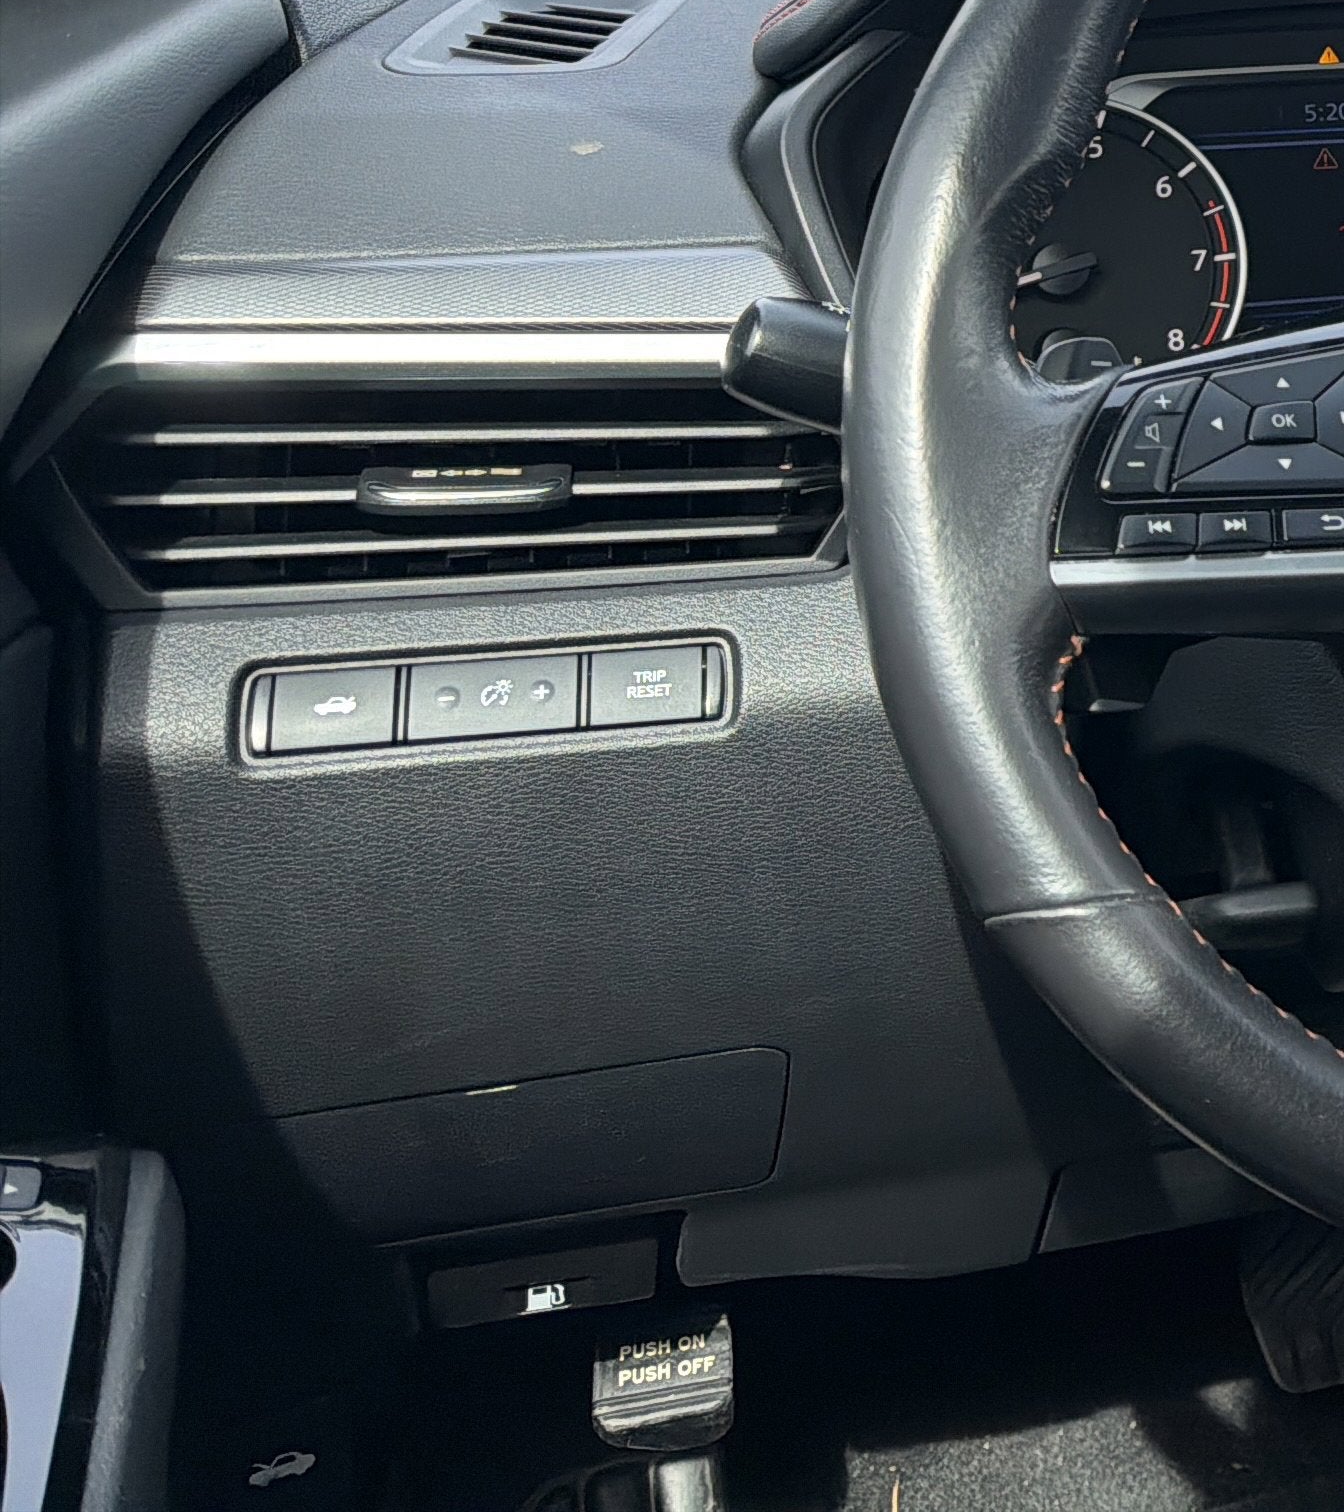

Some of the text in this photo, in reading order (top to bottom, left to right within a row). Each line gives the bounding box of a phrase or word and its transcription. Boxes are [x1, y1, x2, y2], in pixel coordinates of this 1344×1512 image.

[1088, 136, 1103, 158] 5
[1155, 176, 1172, 198] 6
[1190, 249, 1206, 272] 7
[1167, 328, 1185, 351] 8
[1271, 414, 1297, 428] OK
[632, 669, 667, 684] TRIP
[626, 683, 673, 699] RESET
[619, 1333, 706, 1362] PUSH ON
[618, 1354, 716, 1387] PUSH OFF
